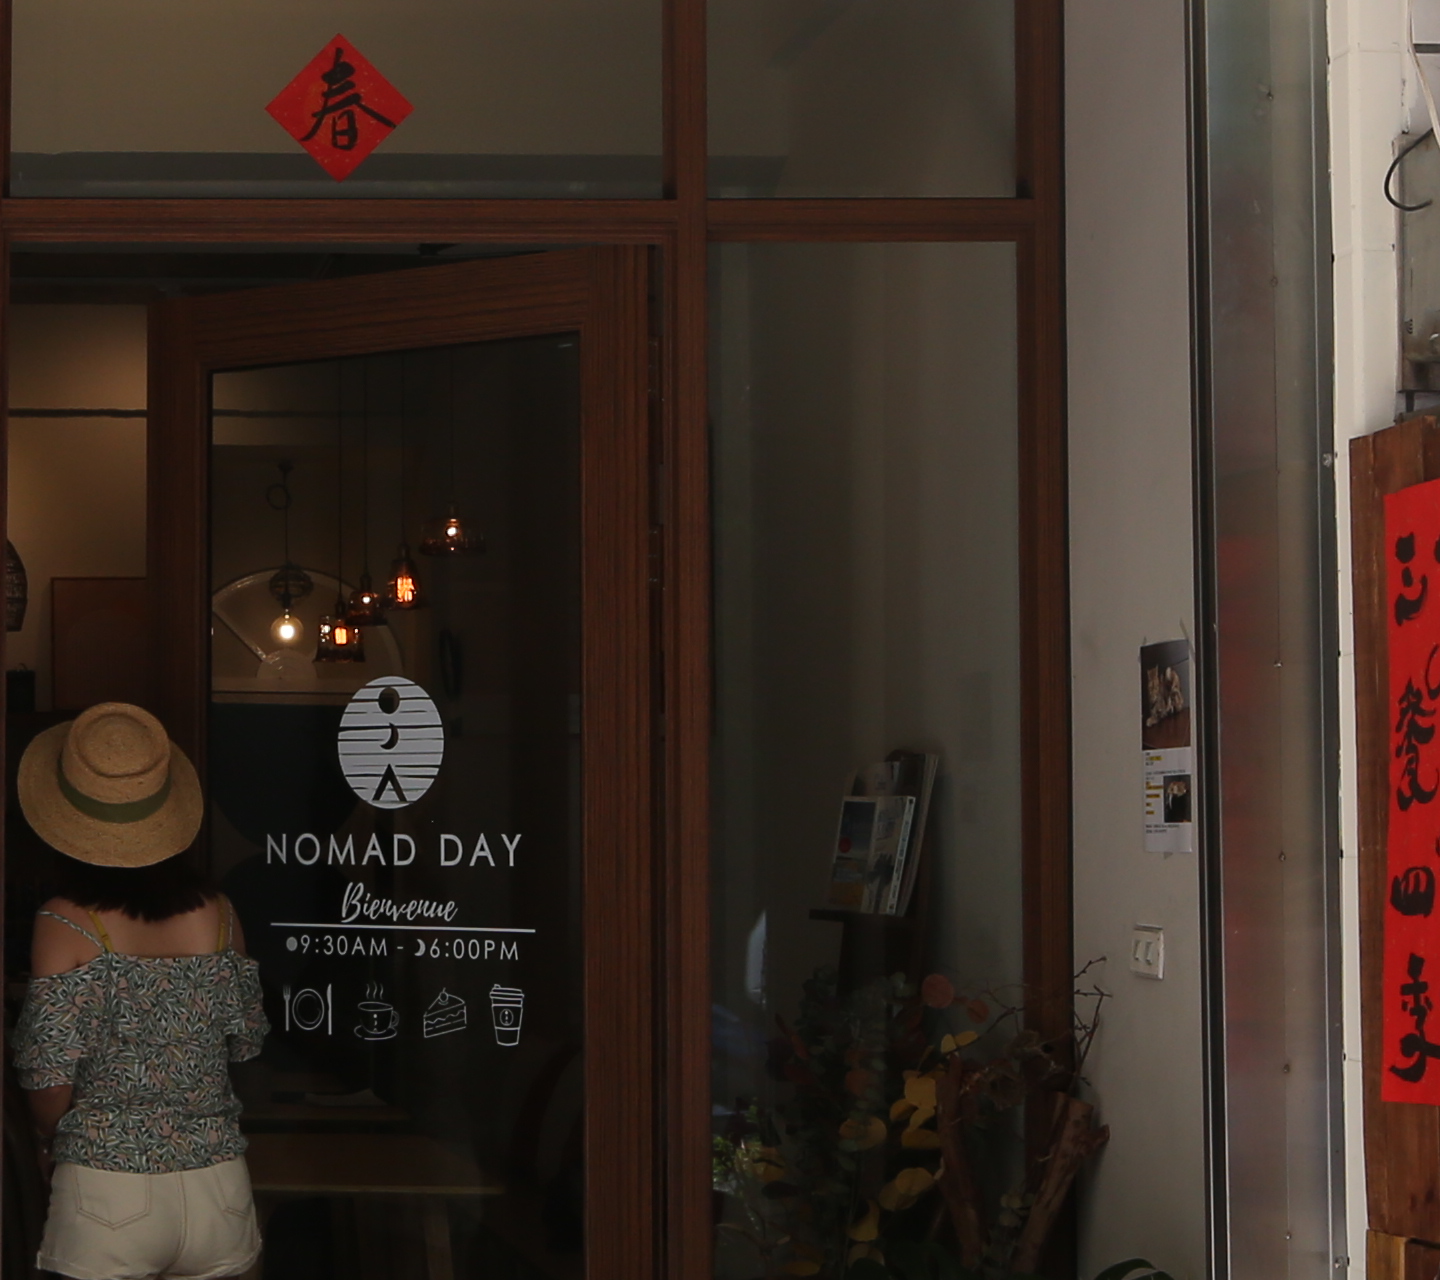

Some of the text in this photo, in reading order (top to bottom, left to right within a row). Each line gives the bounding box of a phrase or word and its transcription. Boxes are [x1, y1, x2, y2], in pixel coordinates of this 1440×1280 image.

[299, 46, 397, 151] 春
[266, 832, 523, 868] NOMAD DAY
[341, 882, 459, 923] Bienvenue
[299, 935, 388, 958] 9:30AM
[428, 938, 519, 961] 6:00PM
